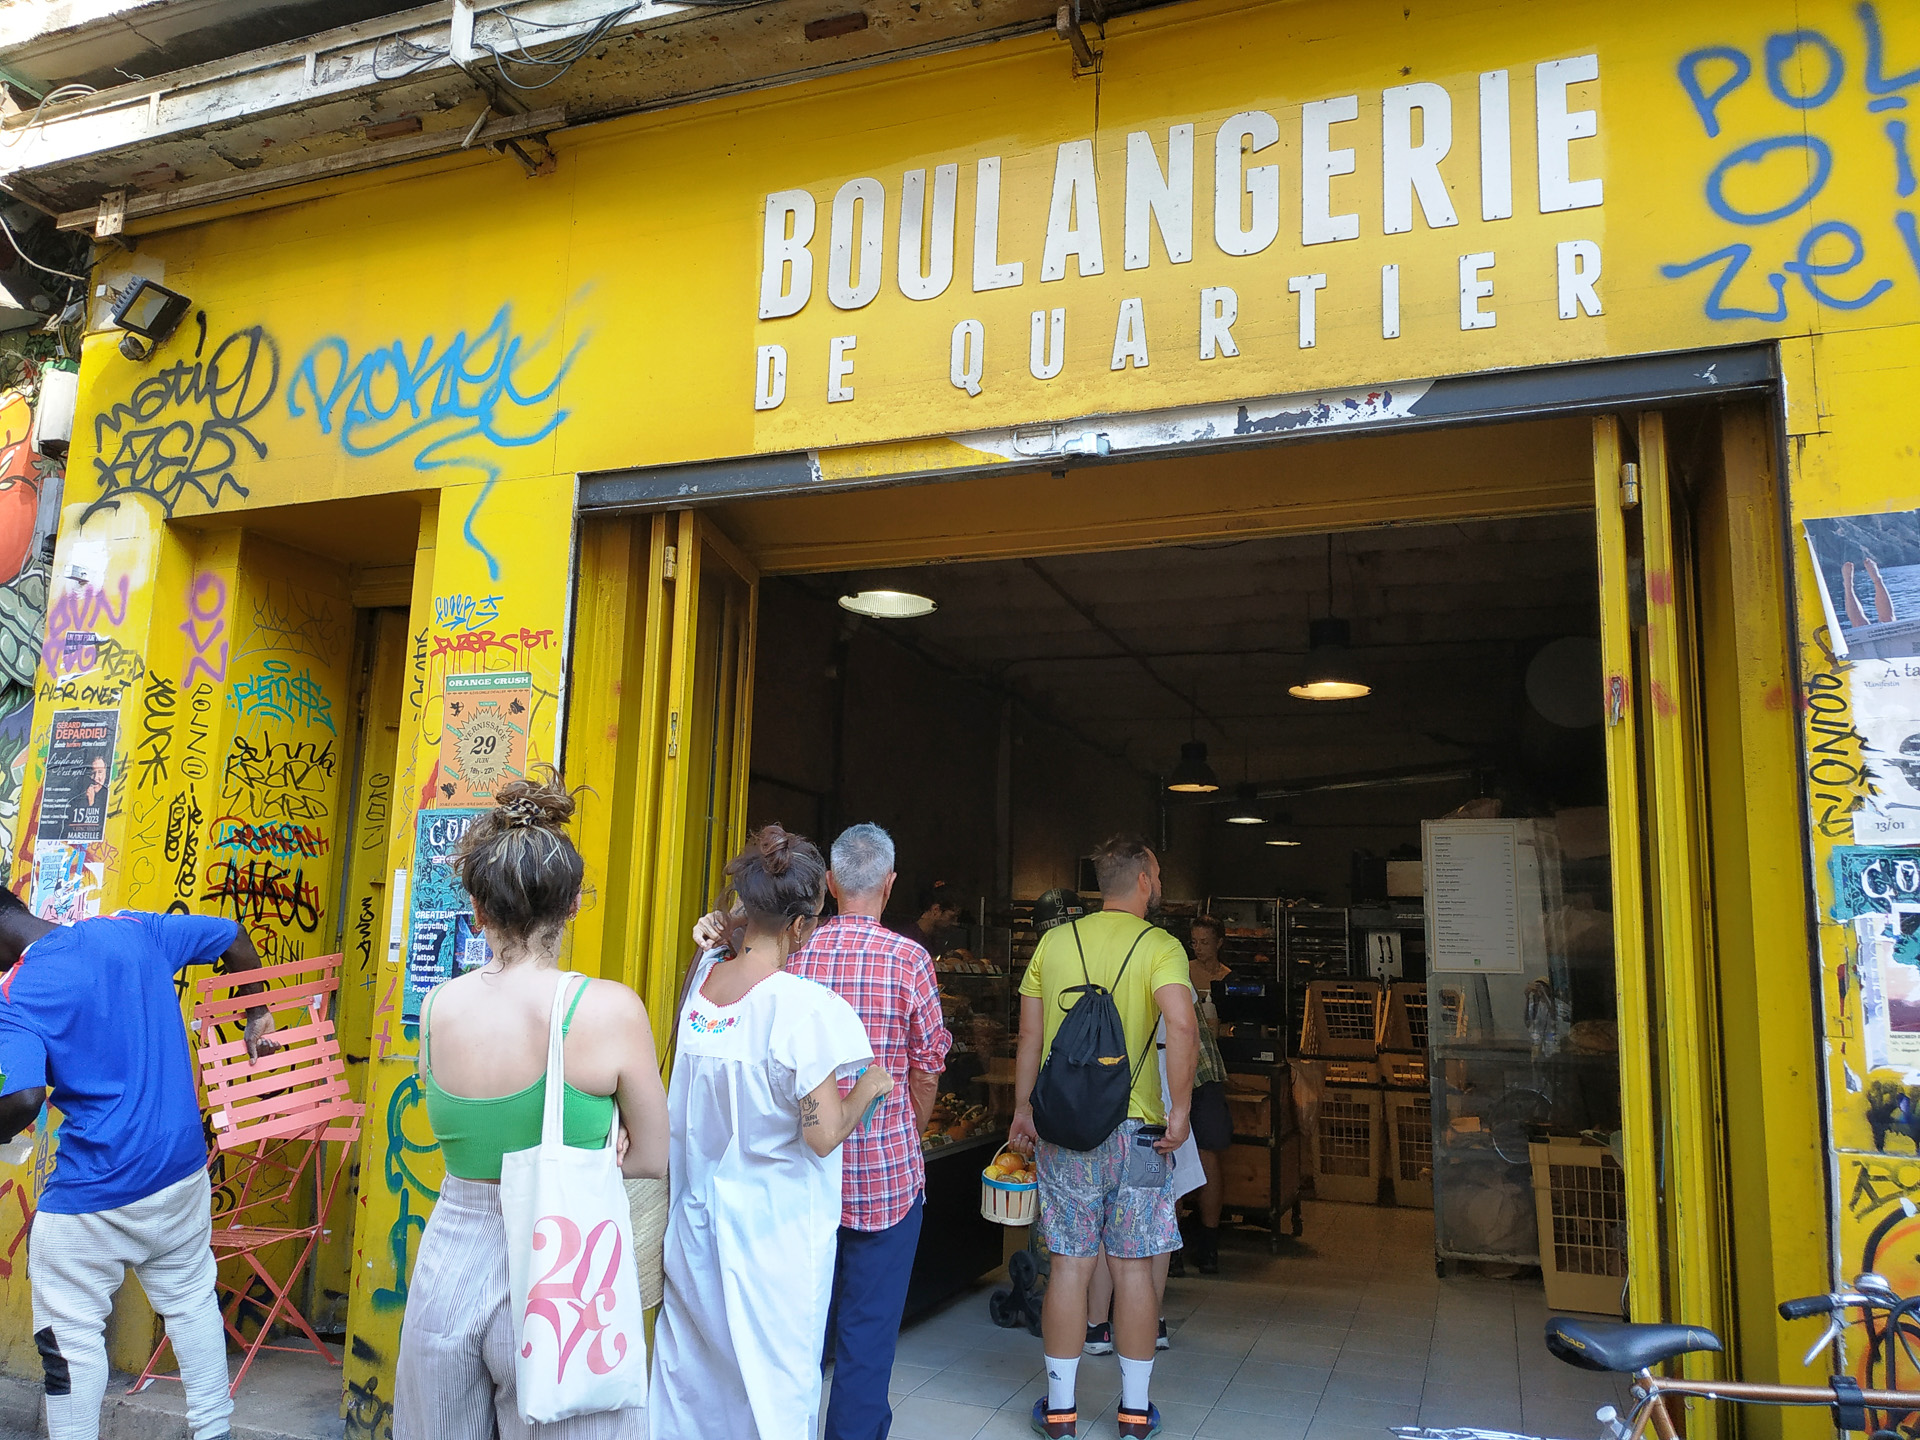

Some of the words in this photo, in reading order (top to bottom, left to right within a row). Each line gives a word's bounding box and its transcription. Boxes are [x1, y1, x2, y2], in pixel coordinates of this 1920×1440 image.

[758, 53, 1604, 320] BOULANGERIE
[755, 335, 858, 411] DE
[949, 240, 1604, 397] QUARTIER
[448, 679, 491, 687] ORANGE
[494, 677, 529, 685] CRUSH
[57, 721, 81, 729] GÉRARD
[56, 728, 107, 739] DEPARDIEU
[464, 721, 508, 742] VERNISSAGE
[470, 735, 496, 755] 29
[484, 766, 495, 774] 22h
[73, 808, 85, 823] 15
[84, 815, 100, 824] 2023
[1875, 818, 1905, 832] 13/01
[67, 831, 100, 840] MARSEILLE
[414, 922, 449, 932] Upcycling
[414, 932, 438, 940] Textile
[412, 943, 435, 952] Bijoux
[412, 953, 436, 961] Tattoo
[411, 964, 445, 972] Broderies
[412, 985, 431, 993] Food
